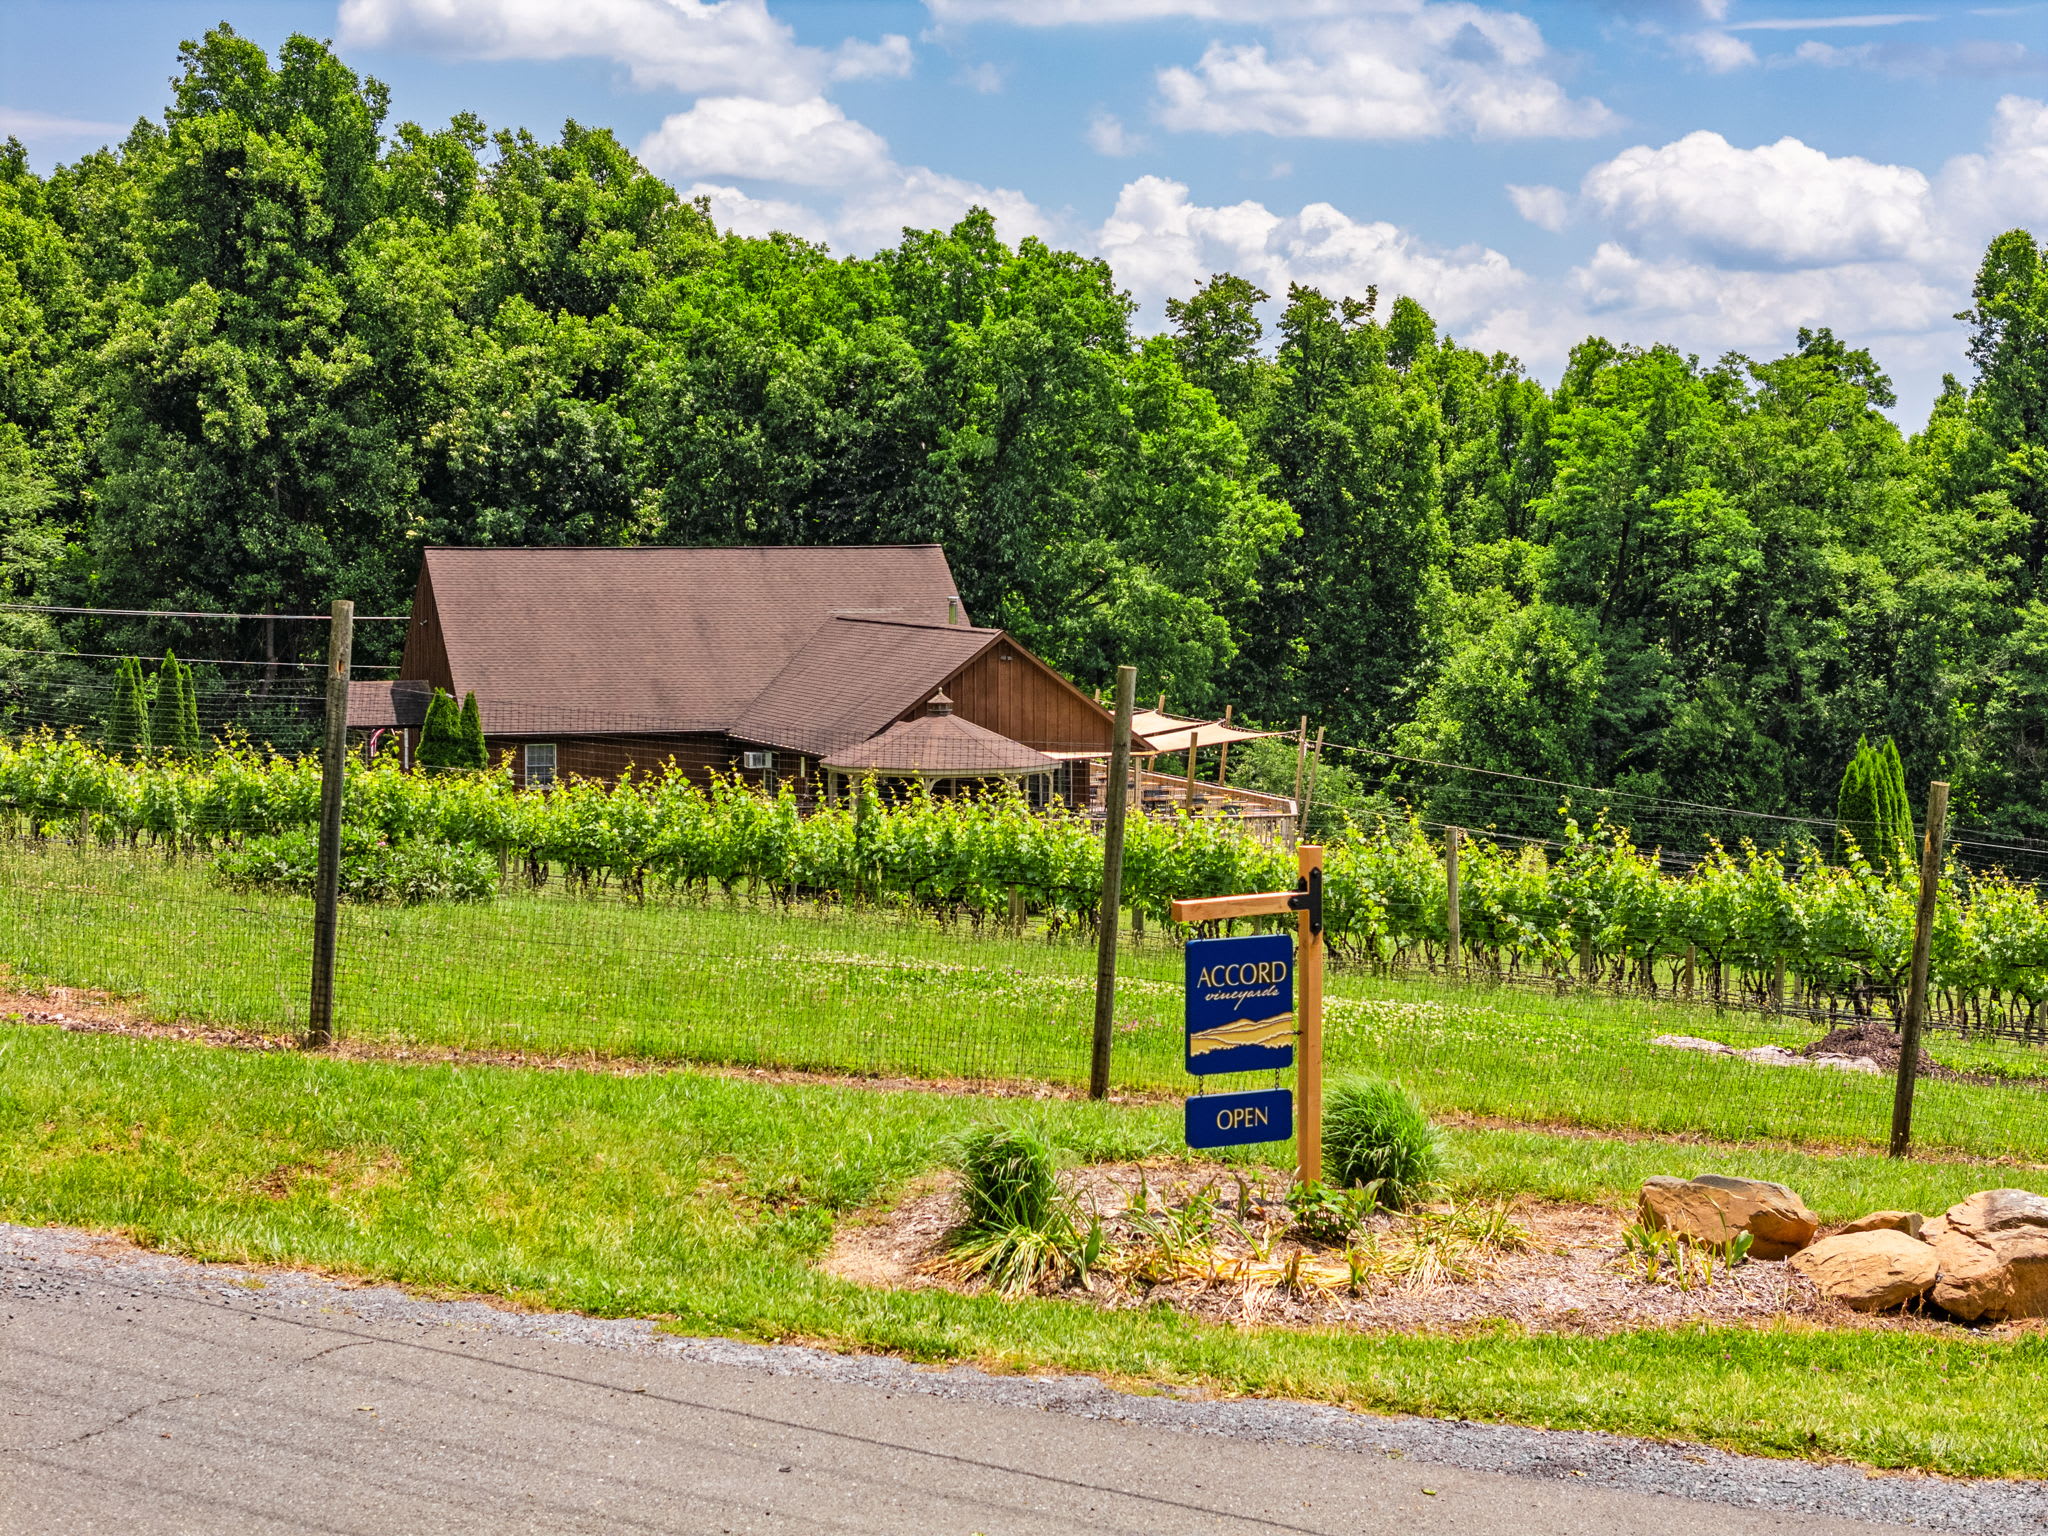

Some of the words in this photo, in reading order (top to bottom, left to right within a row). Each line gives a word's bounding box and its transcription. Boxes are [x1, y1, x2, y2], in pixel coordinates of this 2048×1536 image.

[1197, 960, 1287, 988] ACCORD
[1204, 985, 1280, 1011] vineyards
[1216, 1106, 1269, 1130] OPEN
